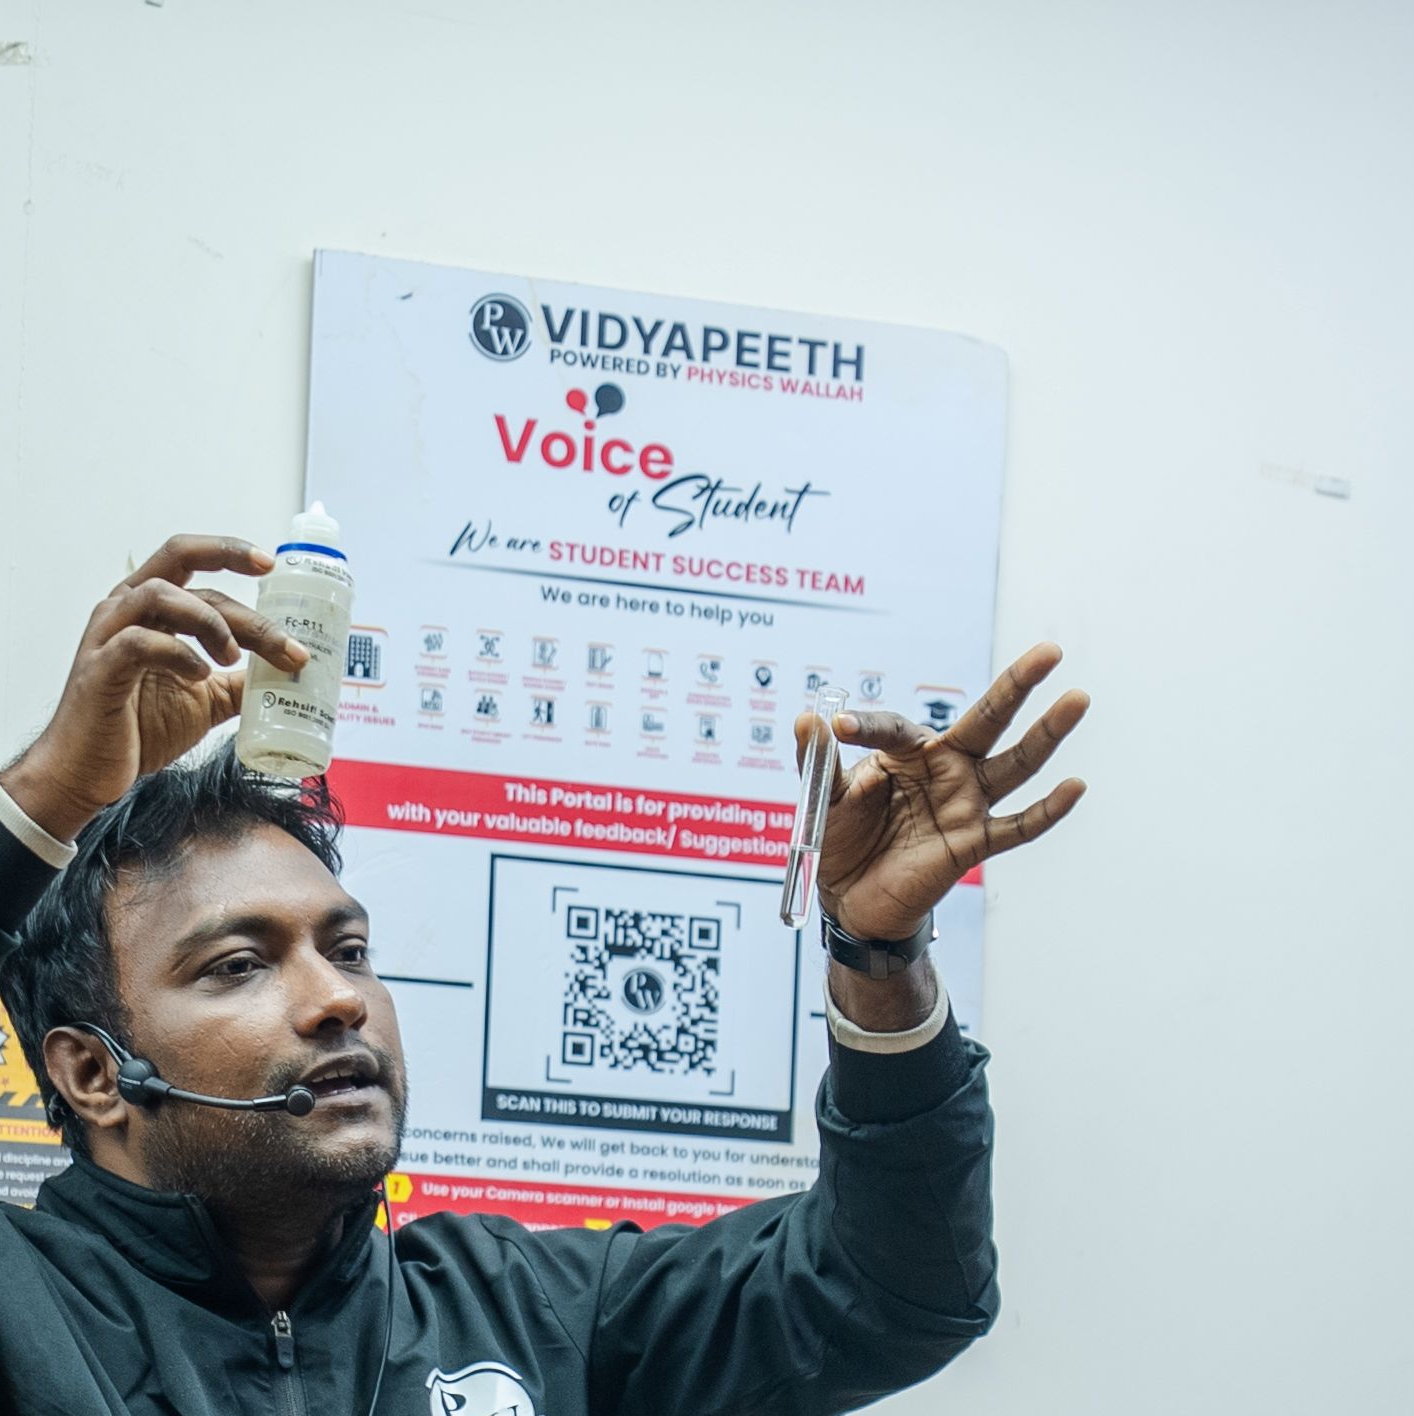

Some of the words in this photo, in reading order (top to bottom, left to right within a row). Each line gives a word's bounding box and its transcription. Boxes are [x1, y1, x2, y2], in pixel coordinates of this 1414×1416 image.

[540, 303, 866, 382] VIDYAPEETH
[549, 348, 651, 376] POWERED
[655, 362, 683, 380] BY
[687, 365, 774, 392] PHYSICS
[780, 377, 864, 403] WALLAH
[493, 413, 674, 481] Voice
[608, 489, 641, 528] of
[651, 472, 832, 538] Student
[449, 518, 501, 556] We
[505, 535, 542, 554] are
[549, 541, 666, 574] STUDENT
[672, 554, 789, 587] SUCCESS
[795, 569, 865, 596] TEAM
[540, 584, 573, 604] We
[577, 593, 611, 608] are
[615, 592, 661, 614] here
[665, 596, 685, 617] to
[690, 600, 733, 623] help
[738, 610, 774, 628] you
[387, 801, 432, 823] with
[434, 808, 482, 829] your
[484, 812, 572, 836] valuable
[573, 818, 677, 850] feedback/
[679, 829, 790, 857] Suggestion
[504, 782, 547, 805] This
[550, 787, 613, 811] Portal
[615, 792, 634, 814] is
[637, 794, 666, 816] for
[667, 800, 767, 832] providing
[769, 812, 794, 829] us
[495, 1093, 540, 1112] SCAN
[543, 1097, 577, 1116] THIS
[579, 1100, 601, 1117] TO
[602, 1101, 657, 1121] SUBMIT
[659, 1106, 702, 1125] YOUR
[703, 1109, 779, 1132] RESPONSE
[2, 1152, 52, 1168] discipline
[399, 1151, 429, 1164] sue
[433, 1150, 481, 1167] better
[486, 1153, 518, 1171] and
[522, 1155, 560, 1173] shall
[564, 1161, 624, 1178] provide
[628, 1167, 639, 1179] a
[642, 1164, 721, 1186] resolution
[724, 1173, 743, 1187] as
[747, 1175, 785, 1190] soon
[403, 1127, 477, 1143] concerns
[481, 1129, 536, 1149] raised,
[540, 1134, 566, 1150] We
[570, 1134, 597, 1152] will
[599, 1140, 626, 1157] get
[630, 1140, 669, 1157] back
[673, 1143, 688, 1159] to
[692, 1148, 722, 1163] you
[724, 1146, 746, 1164] for
[749, 1150, 820, 1169] understa
[5, 1170, 44, 1183] request
[421, 1181, 450, 1197] Use
[451, 1184, 484, 1201] your
[486, 1184, 544, 1203] Camera
[546, 1191, 604, 1207] scanner
[605, 1197, 622, 1208] or
[623, 1195, 665, 1212] Install
[666, 1200, 715, 1217] google
